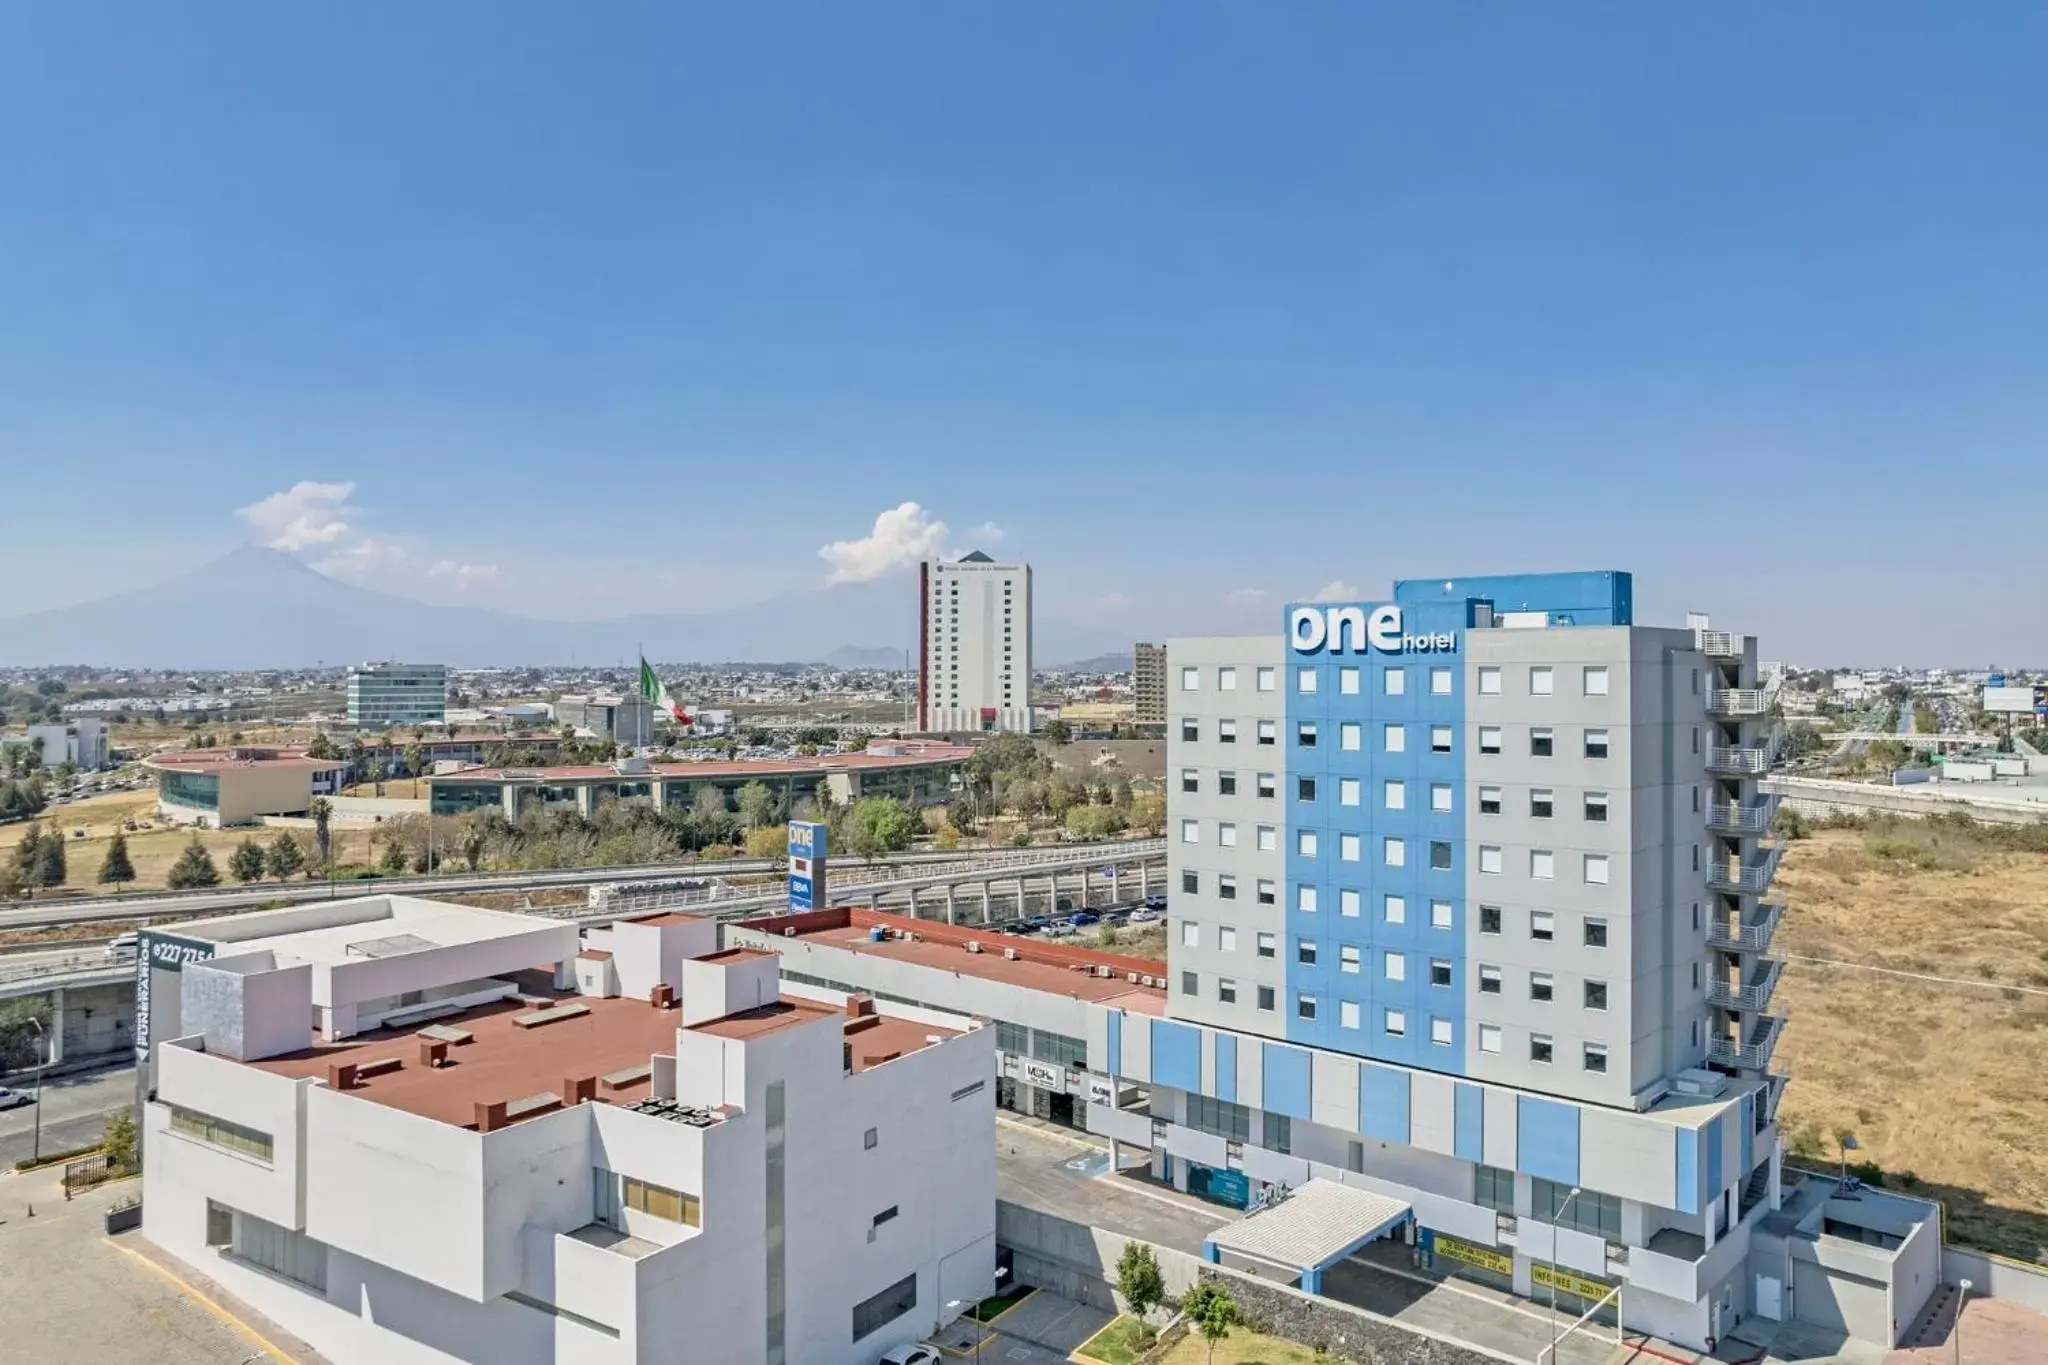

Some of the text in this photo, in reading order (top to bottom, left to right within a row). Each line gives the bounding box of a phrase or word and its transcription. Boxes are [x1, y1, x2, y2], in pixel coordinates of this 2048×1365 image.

[1291, 605, 1401, 651] one
[1403, 631, 1455, 650] hotel
[789, 825, 813, 848] one
[1534, 1267, 1571, 1288] INFOMES
